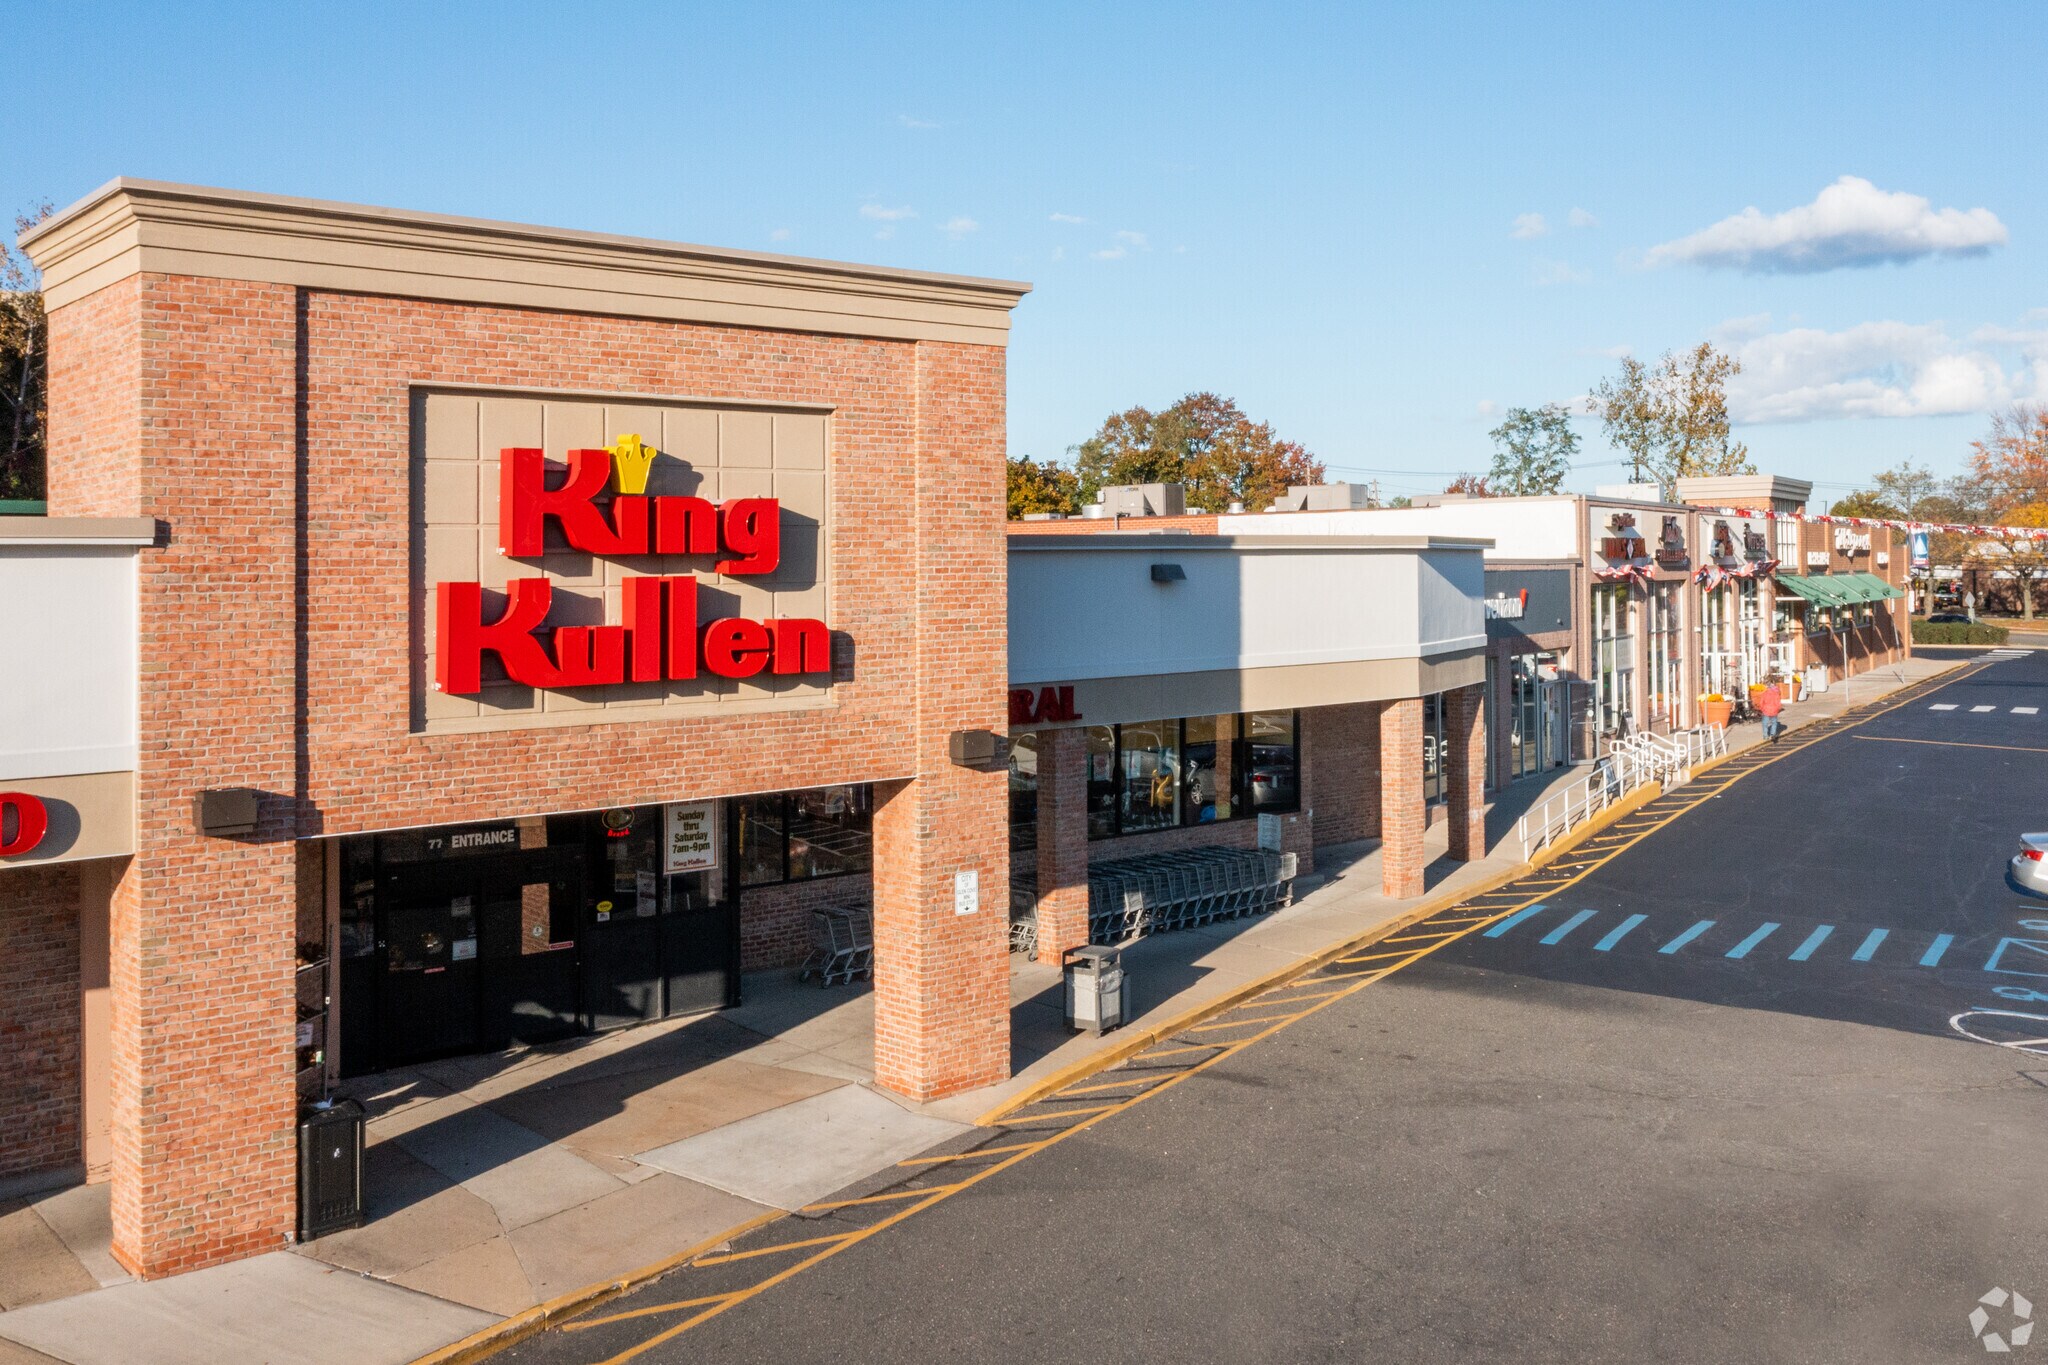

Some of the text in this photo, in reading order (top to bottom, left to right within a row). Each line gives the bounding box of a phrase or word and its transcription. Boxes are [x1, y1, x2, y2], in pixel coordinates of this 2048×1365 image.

[500, 435, 779, 574] King
[436, 576, 830, 695] Kullen
[677, 810, 706, 822] Sunday
[683, 822, 700, 831] thru
[428, 829, 515, 849] 77 ENTRANCE
[674, 831, 708, 843] Saturday
